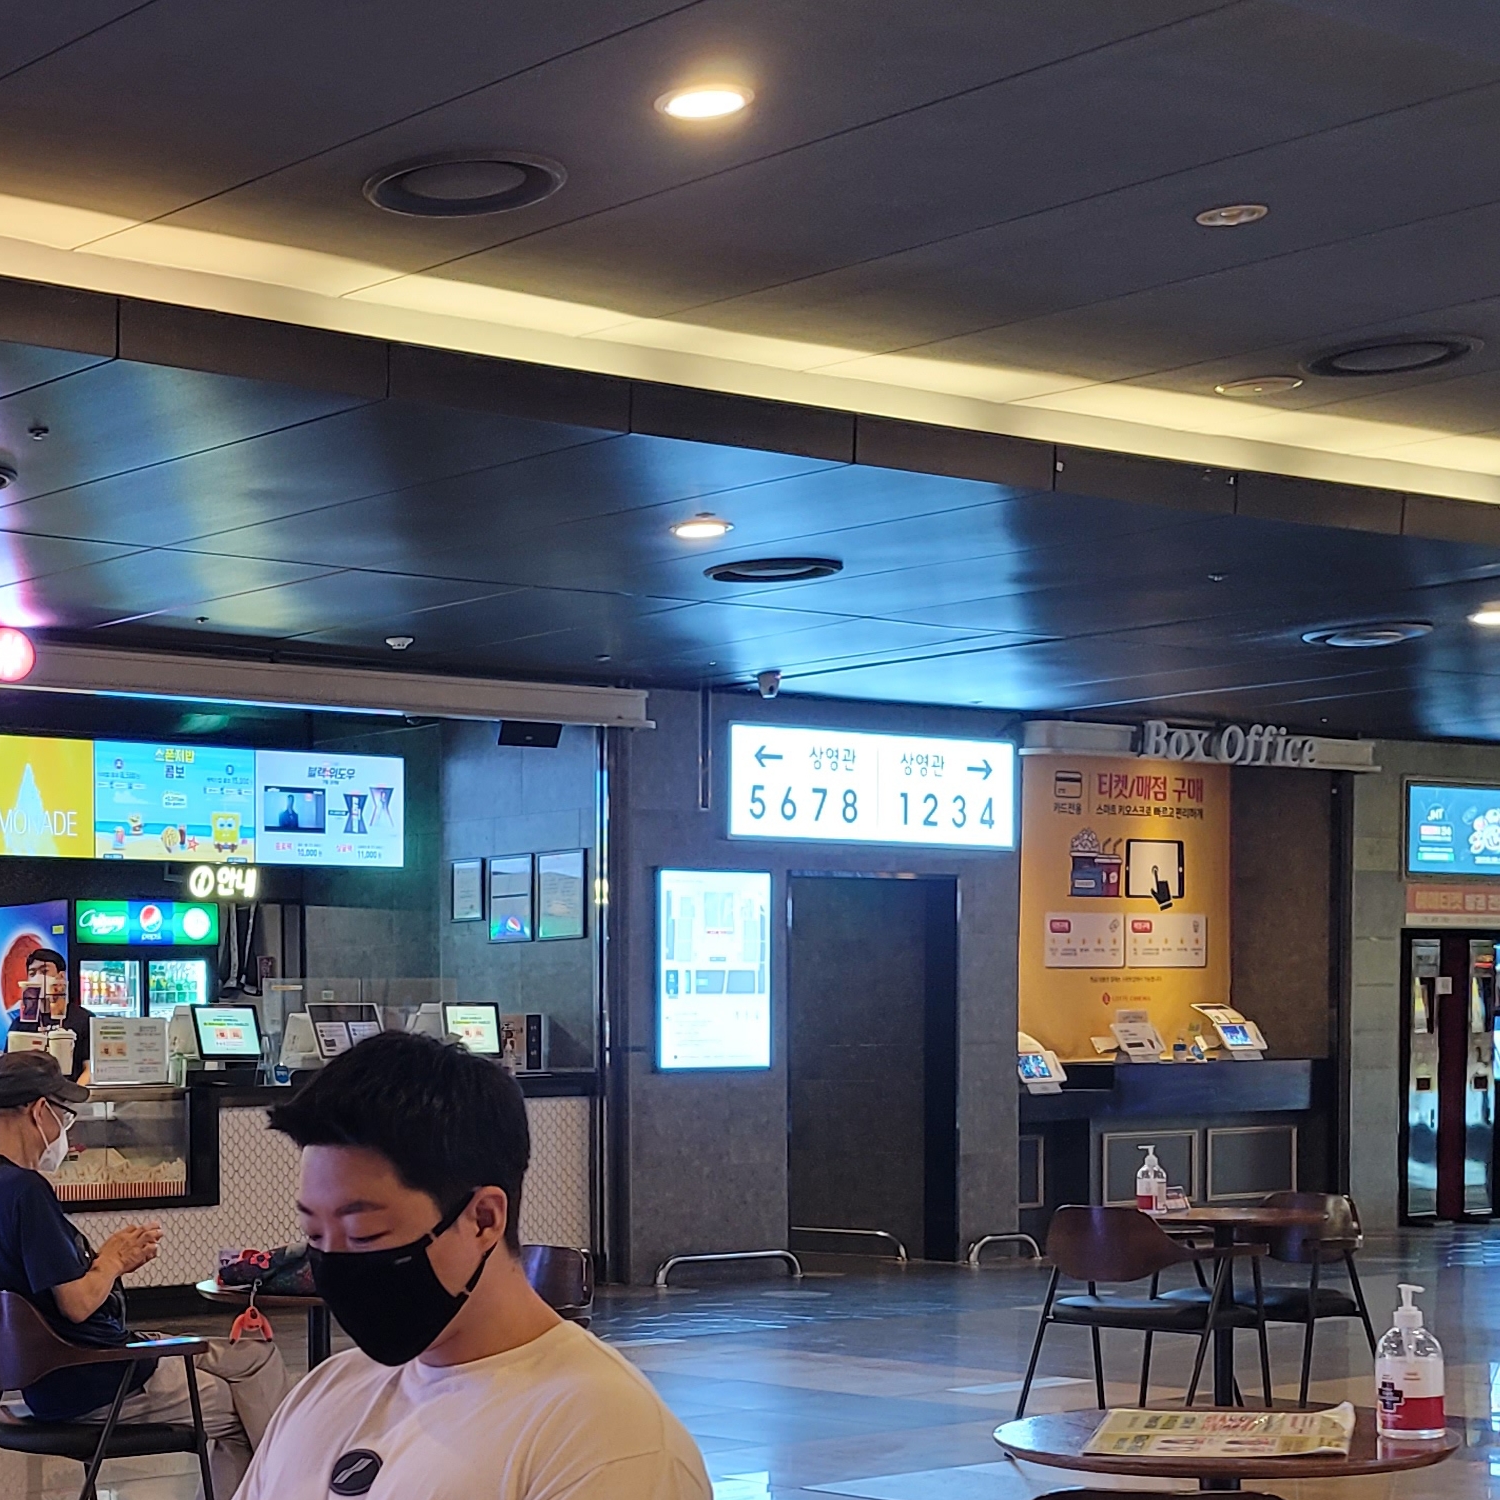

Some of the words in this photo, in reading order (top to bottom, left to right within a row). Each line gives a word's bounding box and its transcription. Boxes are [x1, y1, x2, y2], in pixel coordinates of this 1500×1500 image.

[155, 748, 195, 763] 스폰지밥
[1146, 720, 1209, 759] Box
[1219, 723, 1318, 766] Office
[809, 747, 857, 772] 상영관
[900, 752, 945, 778] 상영관
[1097, 773, 1167, 802] 티켓/매점
[1172, 777, 1204, 803] 구매
[749, 785, 766, 820] 5
[781, 786, 797, 821] 6
[812, 788, 828, 822] 7
[842, 789, 858, 824] 8
[900, 792, 909, 826] 1
[922, 793, 938, 827] 2
[951, 795, 967, 828] 3
[980, 797, 995, 829] 4
[216, 868, 257, 898] 안내
